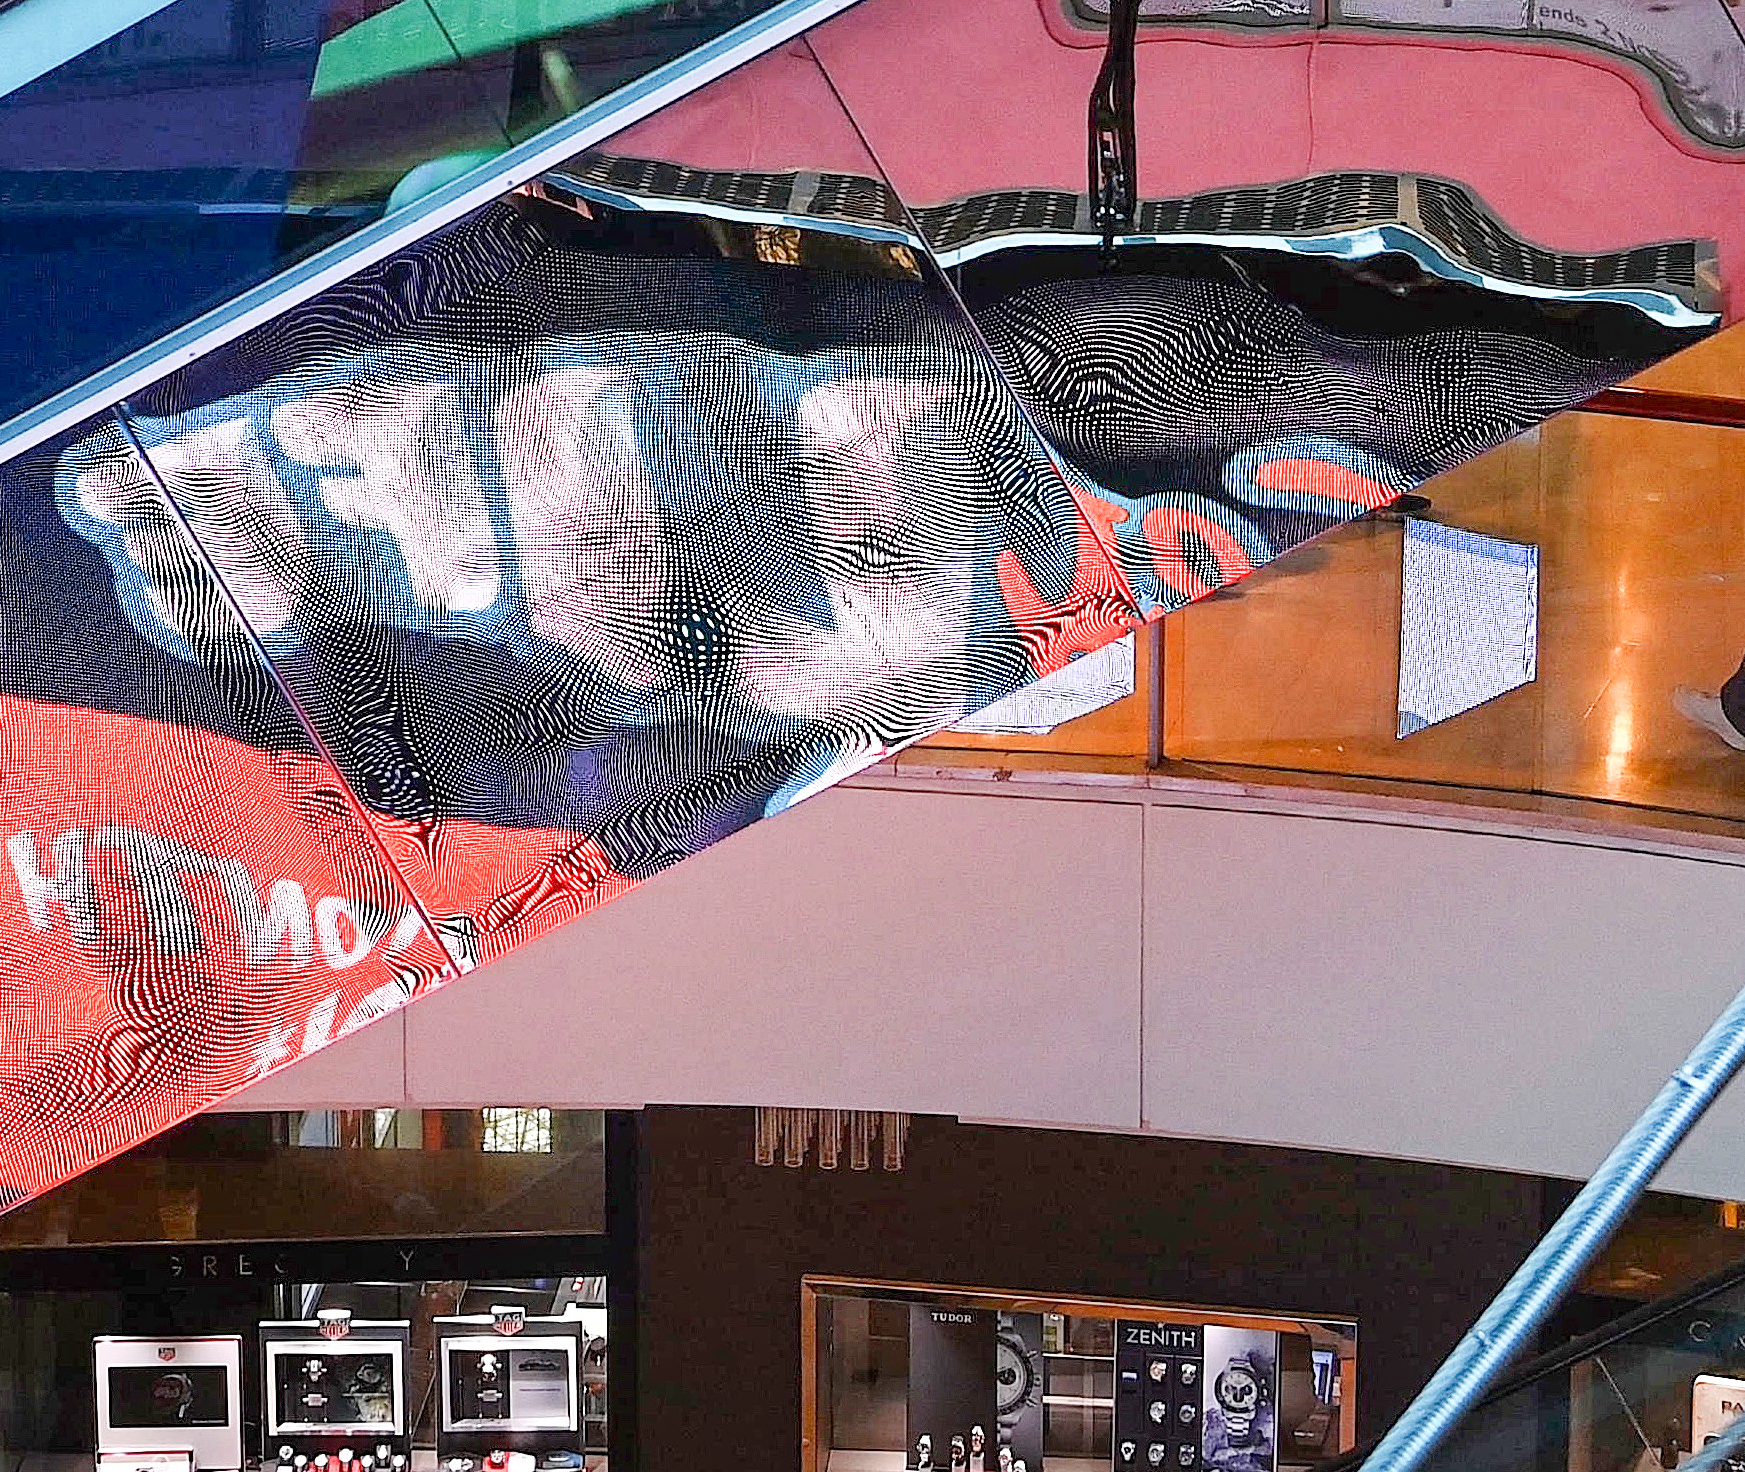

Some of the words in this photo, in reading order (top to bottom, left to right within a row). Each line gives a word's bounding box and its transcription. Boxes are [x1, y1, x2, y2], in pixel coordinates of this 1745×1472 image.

[1538, 5, 1588, 28] ends
[929, 1311, 974, 1325] TUDOR
[1125, 1327, 1196, 1349] ZENITH
